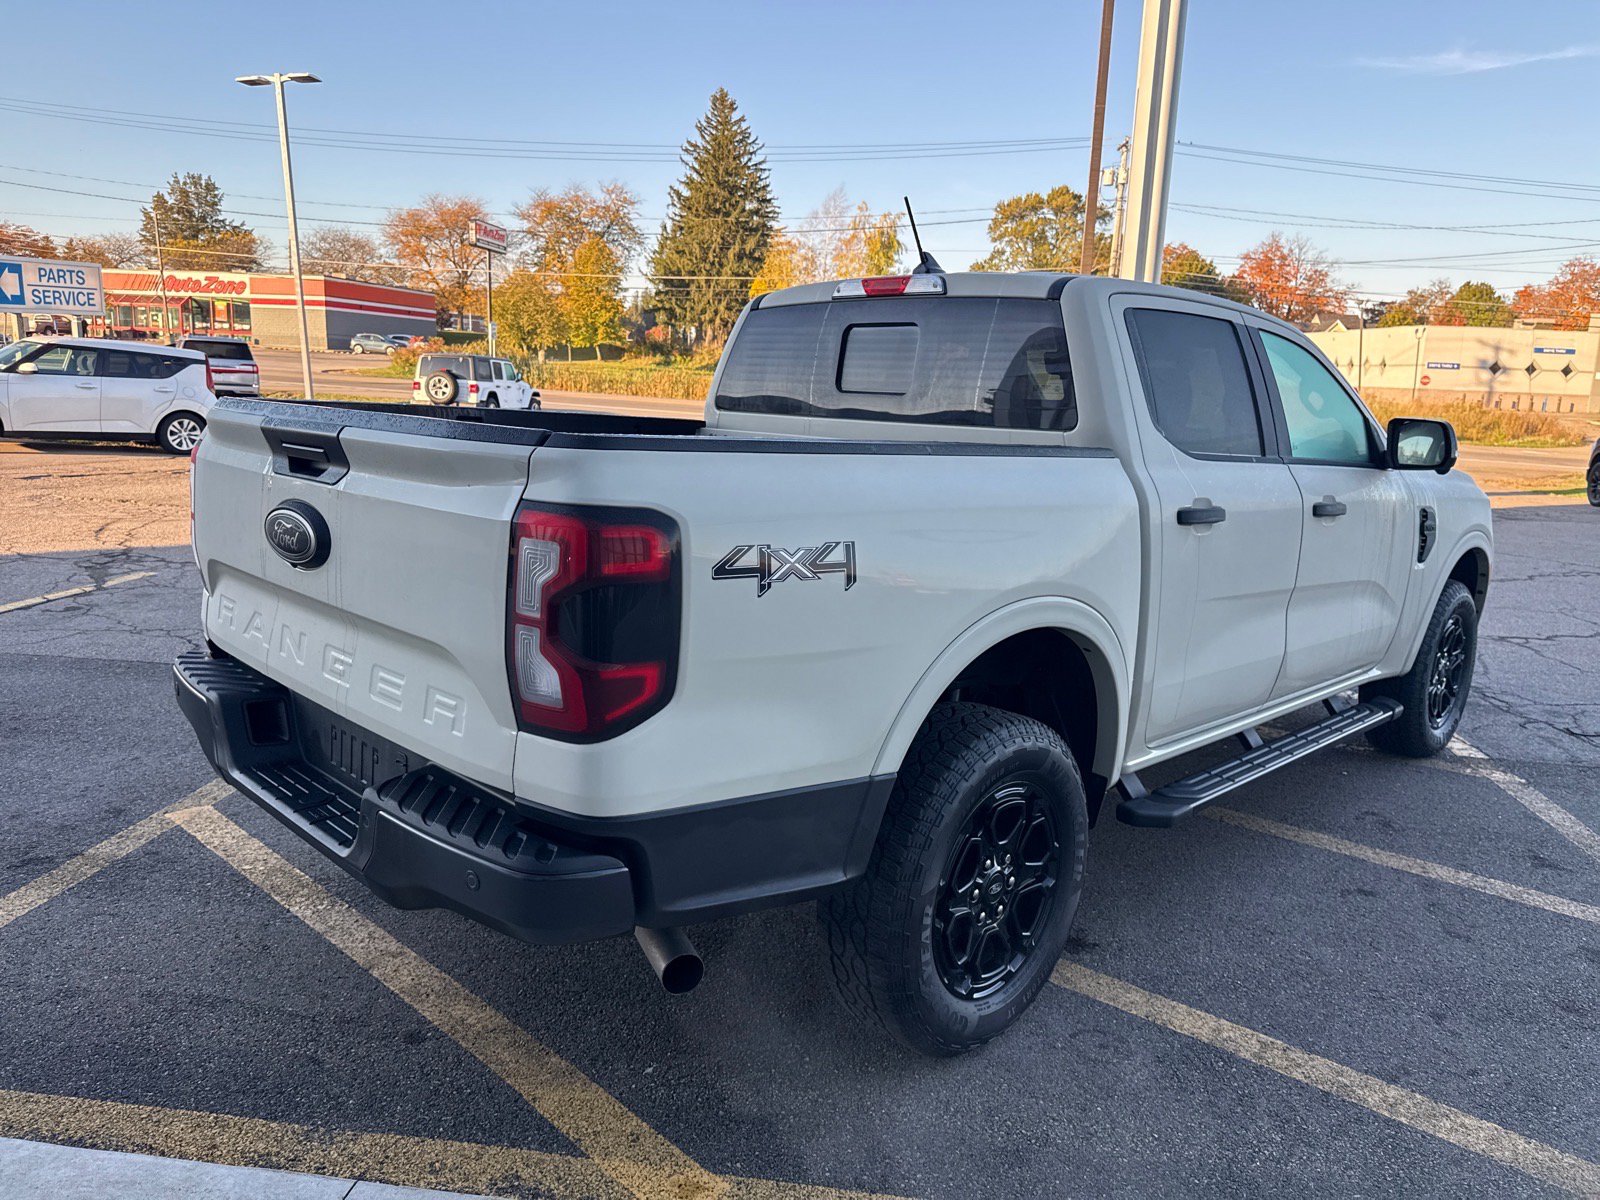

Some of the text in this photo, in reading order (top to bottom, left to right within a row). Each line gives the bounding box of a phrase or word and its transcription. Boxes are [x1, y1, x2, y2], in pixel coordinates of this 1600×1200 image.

[38, 267, 86, 285] PARTS
[161, 275, 247, 295] AutoZone
[31, 288, 97, 307] SERVICE
[272, 519, 299, 550] Ford
[217, 594, 467, 737] RANGER
